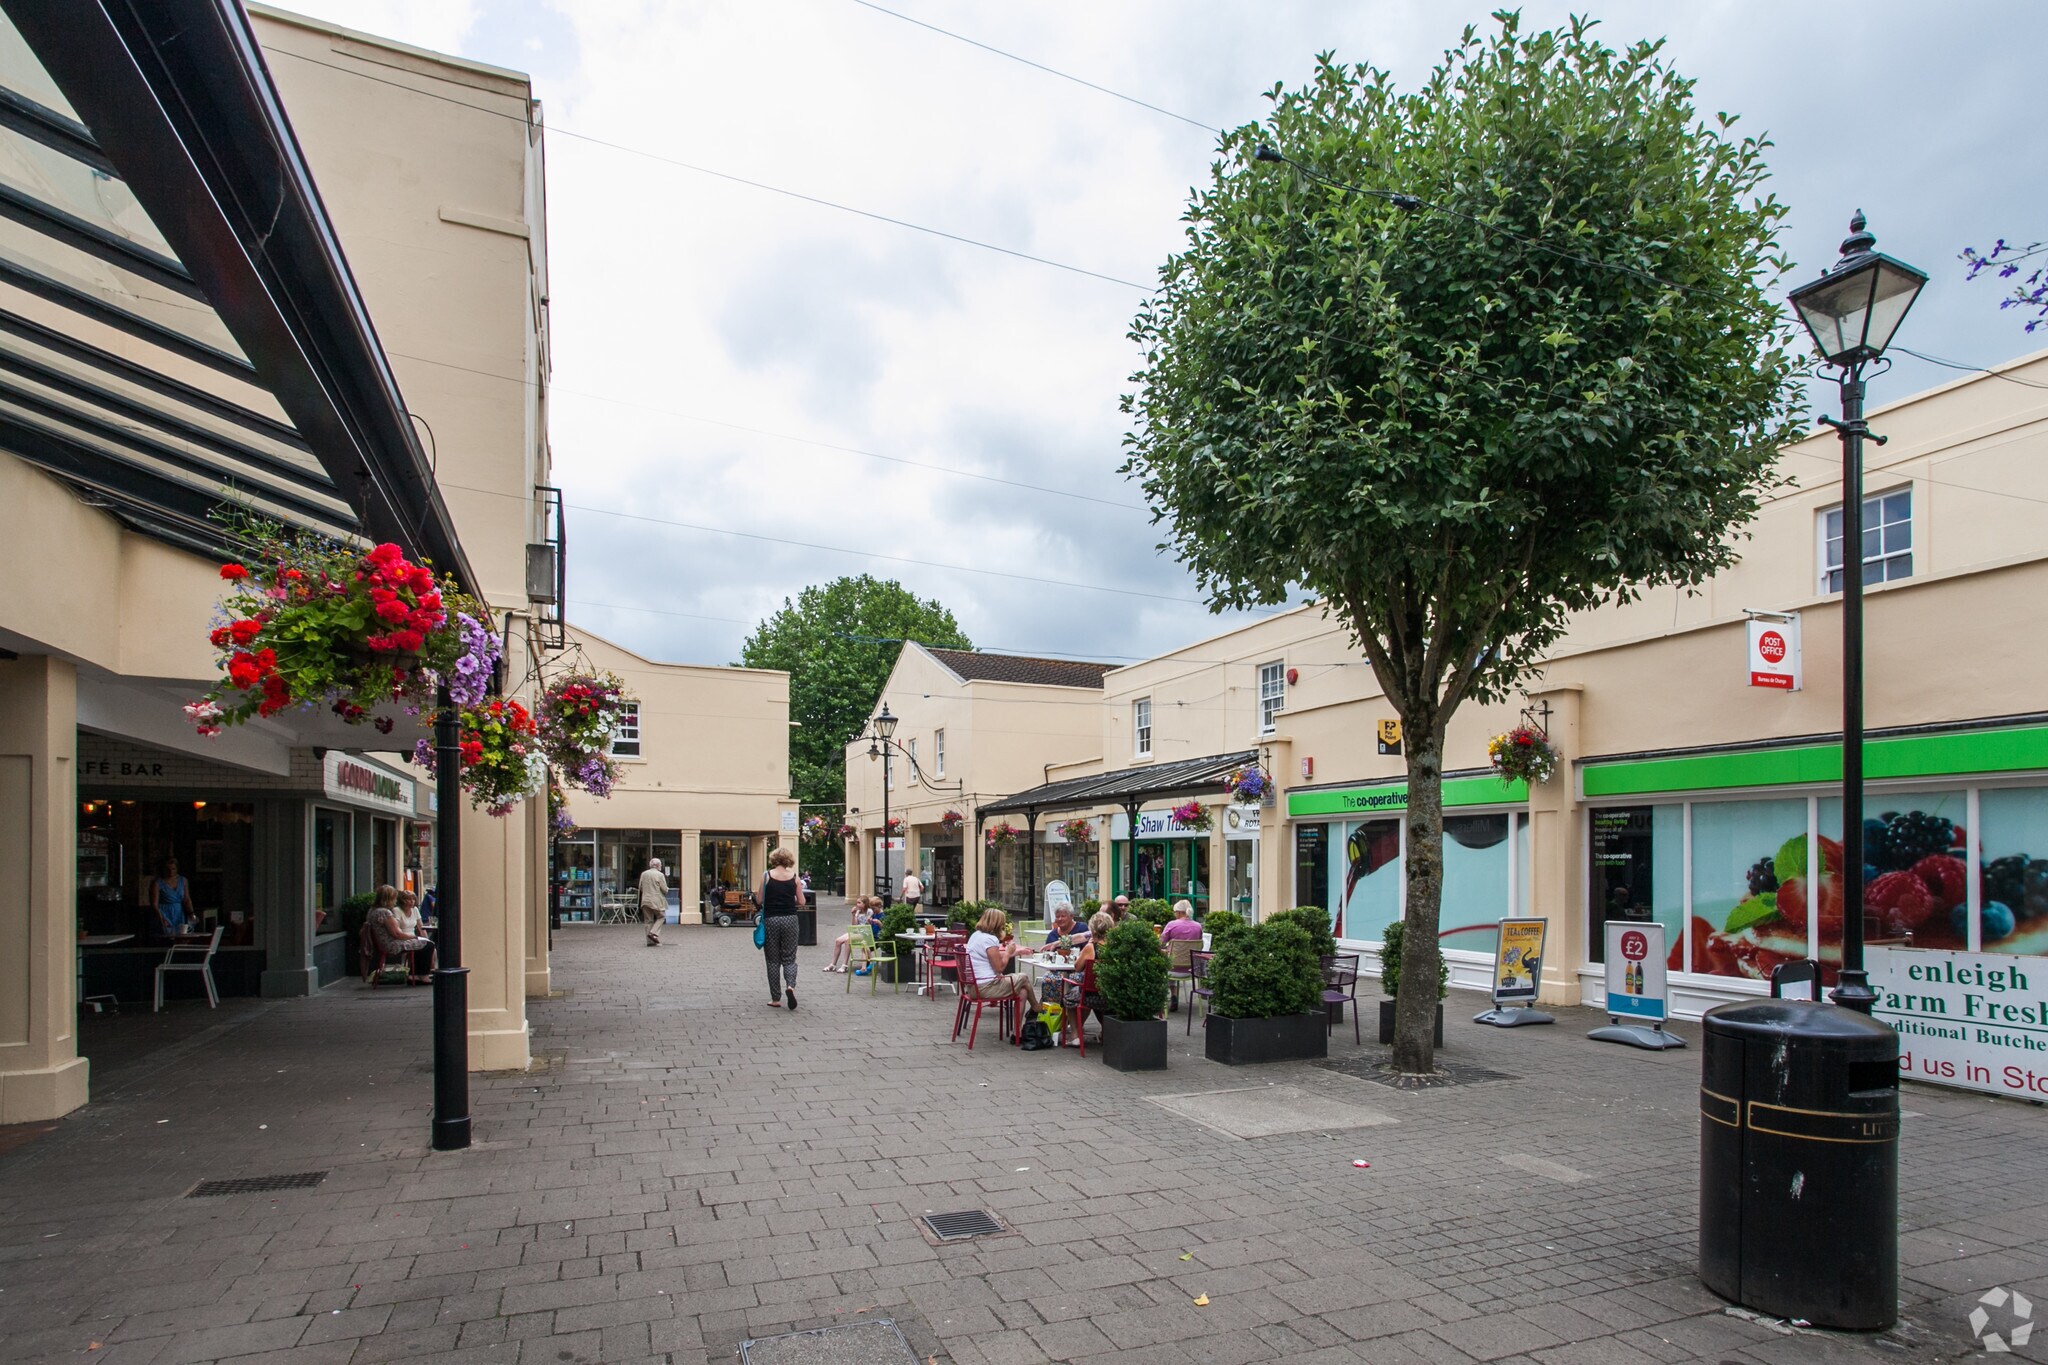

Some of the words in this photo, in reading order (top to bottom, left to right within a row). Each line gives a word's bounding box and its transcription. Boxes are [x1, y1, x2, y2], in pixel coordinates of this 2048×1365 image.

[1764, 637, 1781, 647] POST
[1761, 646, 1783, 656] OFFICE
[121, 762, 164, 776] BAR
[1343, 796, 1356, 808] The
[1356, 792, 1408, 808] co-operative
[1140, 817, 1165, 833] Shaw
[1506, 927, 1518, 936] TEA
[1520, 926, 1540, 936] COFFEE
[1625, 940, 1643, 956] £2
[1908, 960, 2029, 993] enleigh
[1870, 984, 1946, 1014] Farm
[1923, 1058, 1956, 1078] us
[1966, 1060, 1991, 1084] in
